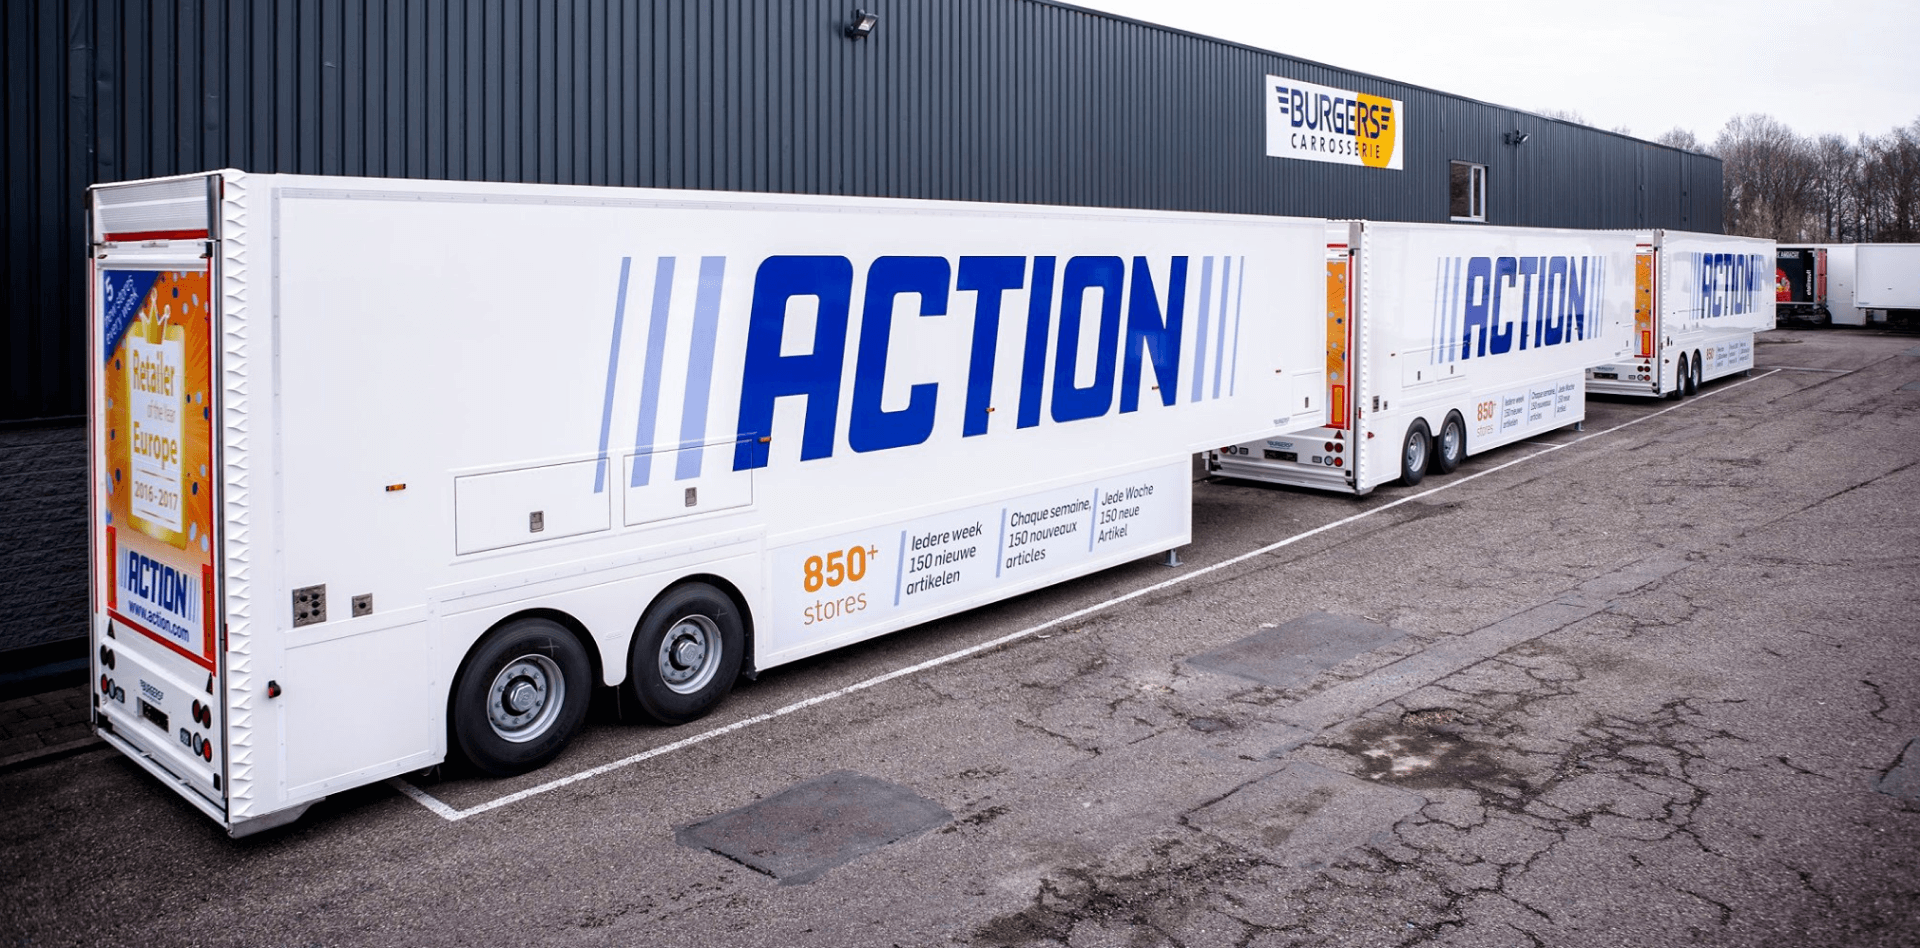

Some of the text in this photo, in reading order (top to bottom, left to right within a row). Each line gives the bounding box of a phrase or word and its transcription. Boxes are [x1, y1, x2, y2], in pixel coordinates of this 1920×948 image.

[1291, 88, 1381, 139] BURGERS
[1291, 132, 1380, 159] CARROSSERIE
[105, 275, 114, 302] 5
[1701, 252, 1754, 319] ACTION
[1462, 256, 1588, 360] ACTION
[133, 350, 176, 397] Retailer
[732, 255, 1189, 472] ACTION
[134, 421, 178, 470] Europe
[1102, 483, 1154, 507] Jede Woche
[1010, 497, 1091, 528] Chaque semaine,
[1100, 504, 1140, 525] 150 neue
[911, 522, 983, 552] Iedere week
[1009, 520, 1077, 548] 150 nouveaux
[1098, 524, 1128, 544] Artikel
[909, 545, 977, 574] 150 nieuwe
[1005, 546, 1046, 569] articles
[128, 551, 187, 618] ACTION
[906, 568, 960, 596] artikelen
[128, 600, 190, 642] www.action.com
[804, 591, 867, 626] stores
